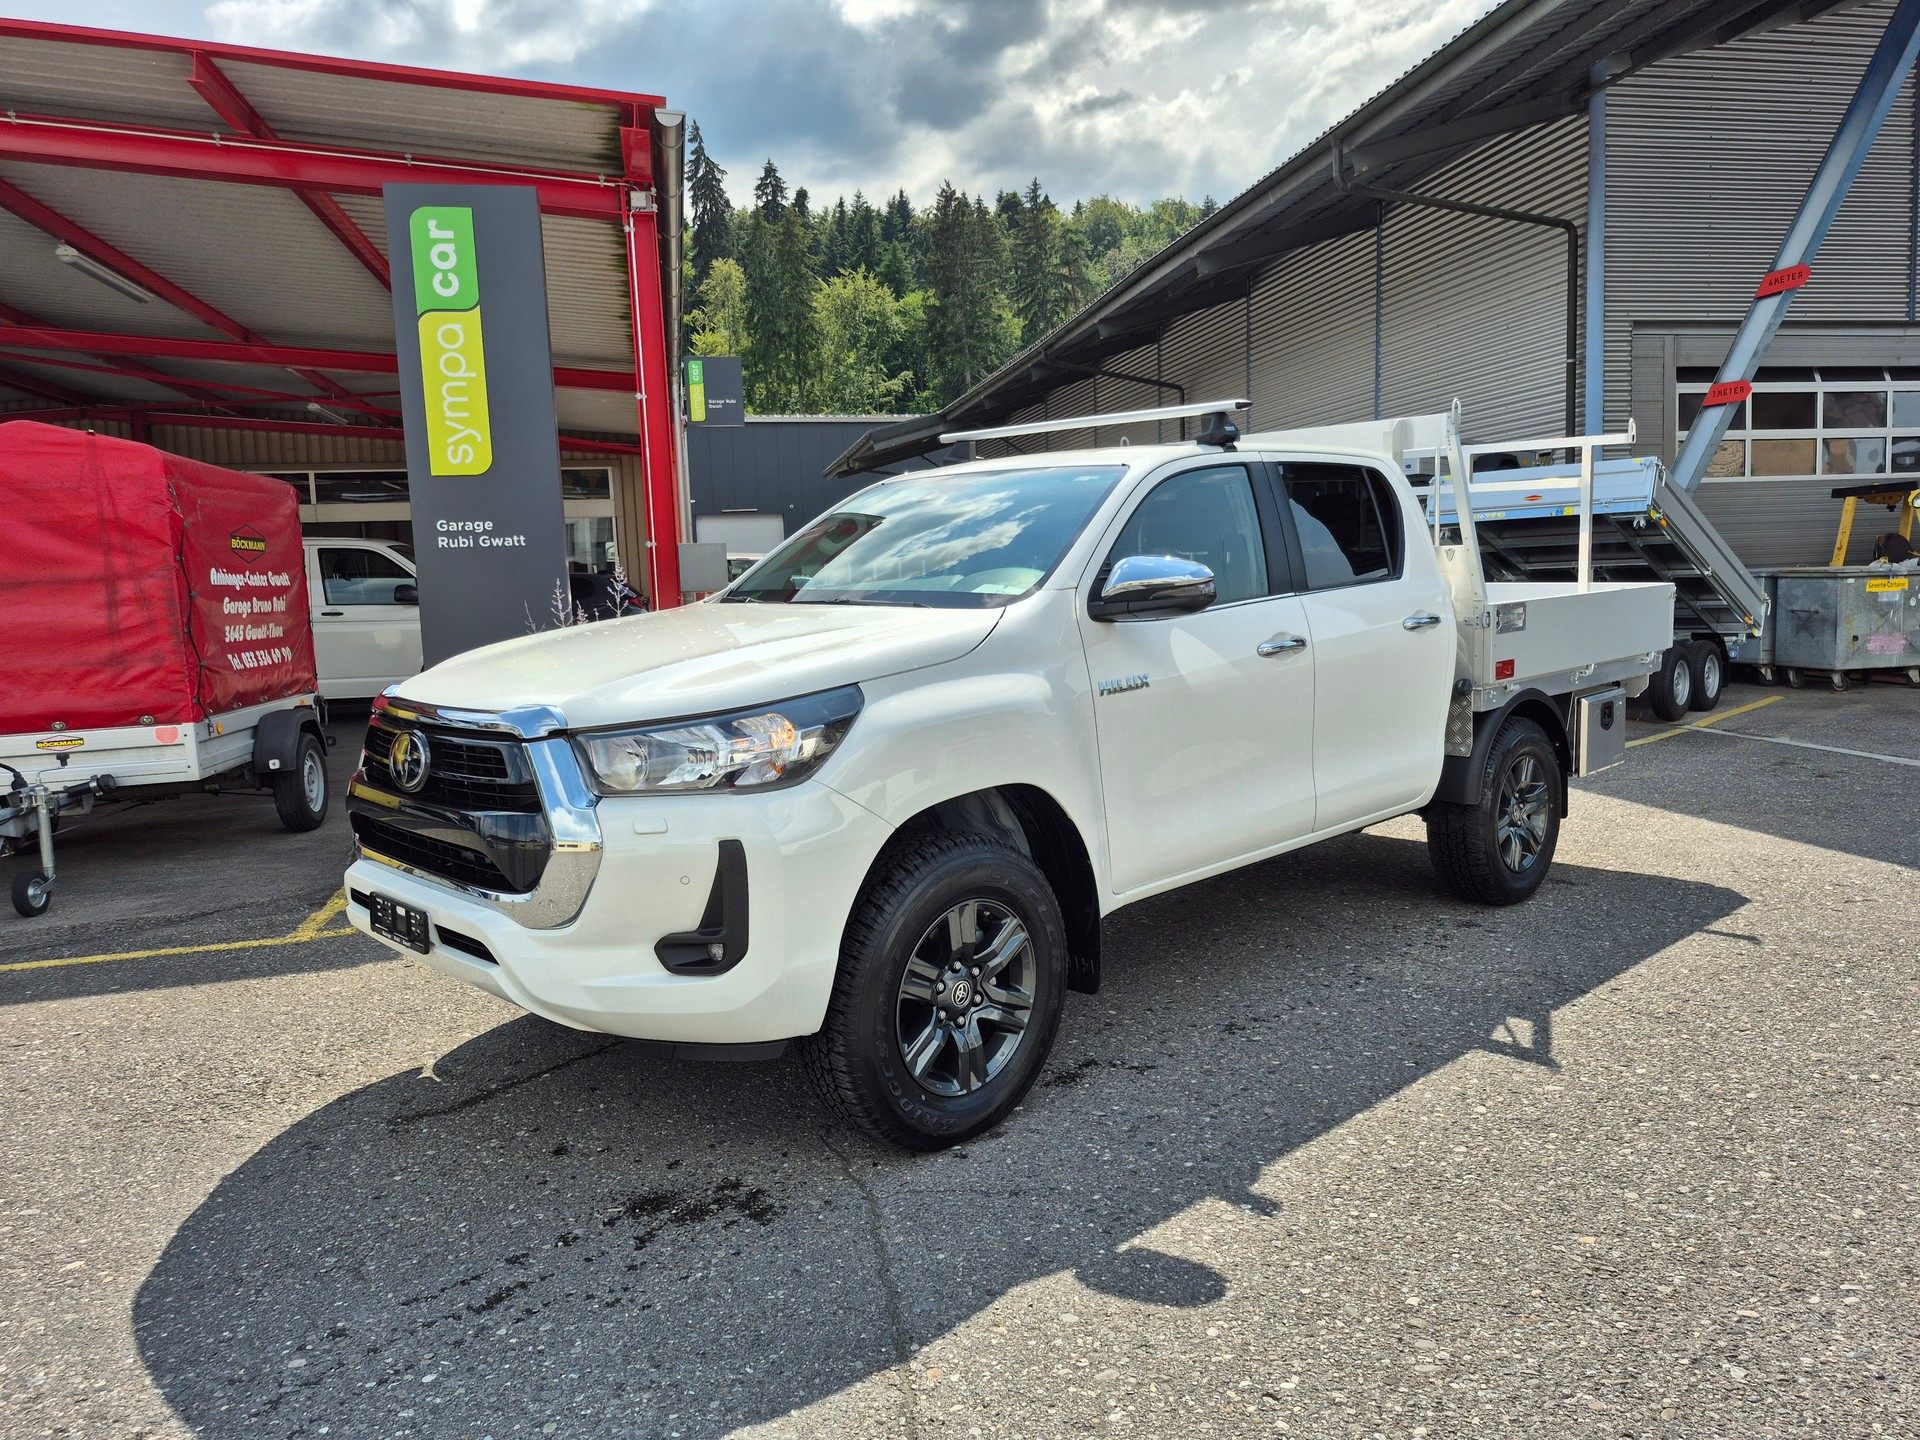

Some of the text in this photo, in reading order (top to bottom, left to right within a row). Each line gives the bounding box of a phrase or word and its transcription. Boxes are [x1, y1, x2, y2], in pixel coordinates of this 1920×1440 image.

[427, 219, 482, 465] sympa car
[436, 520, 494, 533] Garage
[231, 537, 266, 551] BÖCKMANN
[438, 535, 526, 548] Rubi Gwatt
[268, 571, 291, 587] Gwatt
[223, 595, 286, 618] Garage Bruno Rubi
[225, 625, 244, 643] 3645
[227, 646, 292, 671] Tel. 033 336 69 90
[1098, 673, 1150, 697] HILUX
